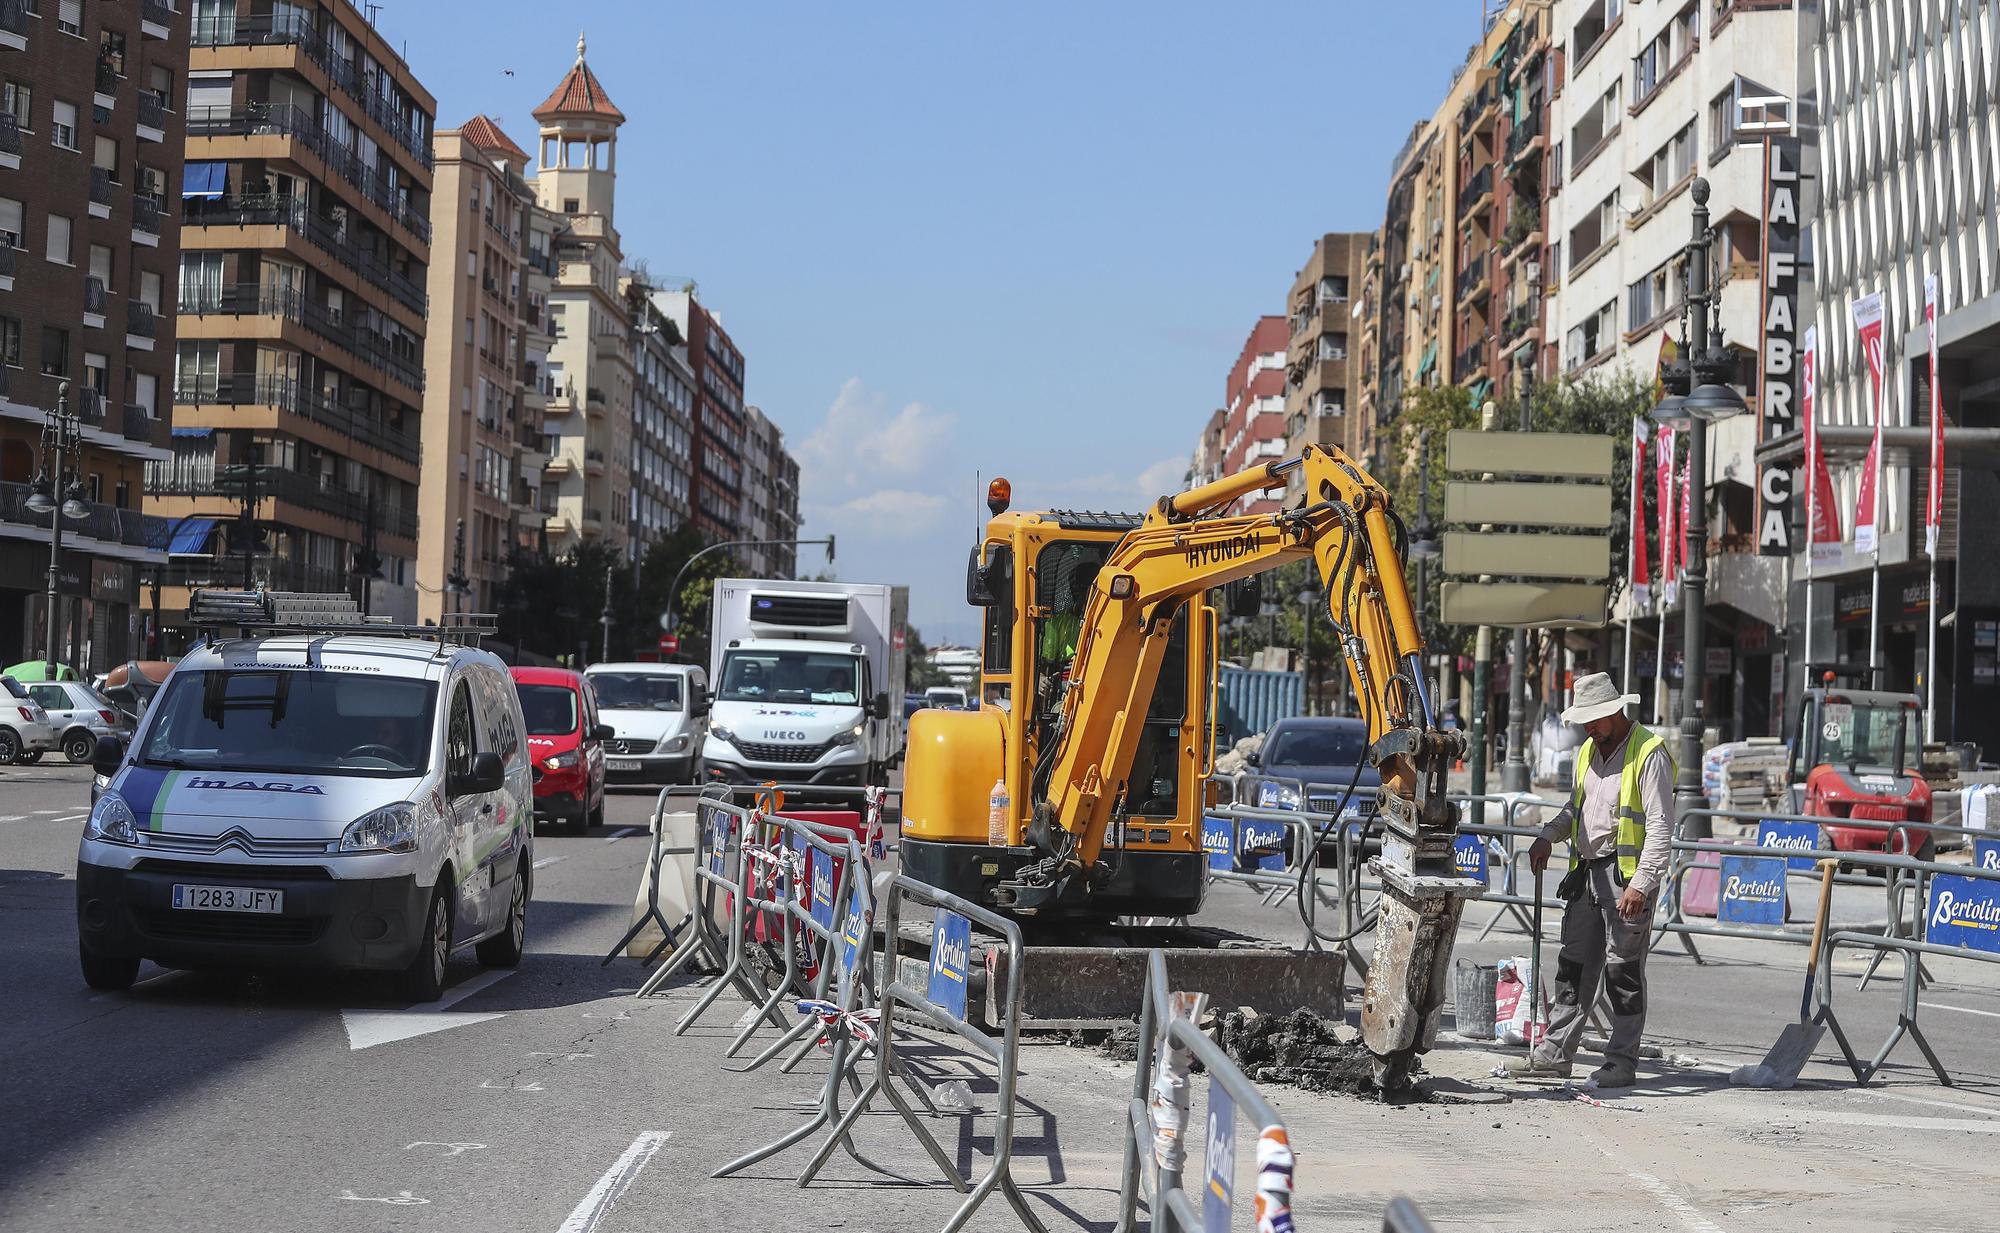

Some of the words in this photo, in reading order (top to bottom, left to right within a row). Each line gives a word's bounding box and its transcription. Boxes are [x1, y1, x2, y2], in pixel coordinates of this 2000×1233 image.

[1768, 144, 1797, 225] LA
[1189, 531, 1260, 569] HYUNDAI
[723, 590, 734, 599] 117
[764, 730, 806, 740] IVECO
[1826, 724, 1839, 737] 25
[189, 888, 235, 908] 1283
[243, 891, 278, 911] JFY
